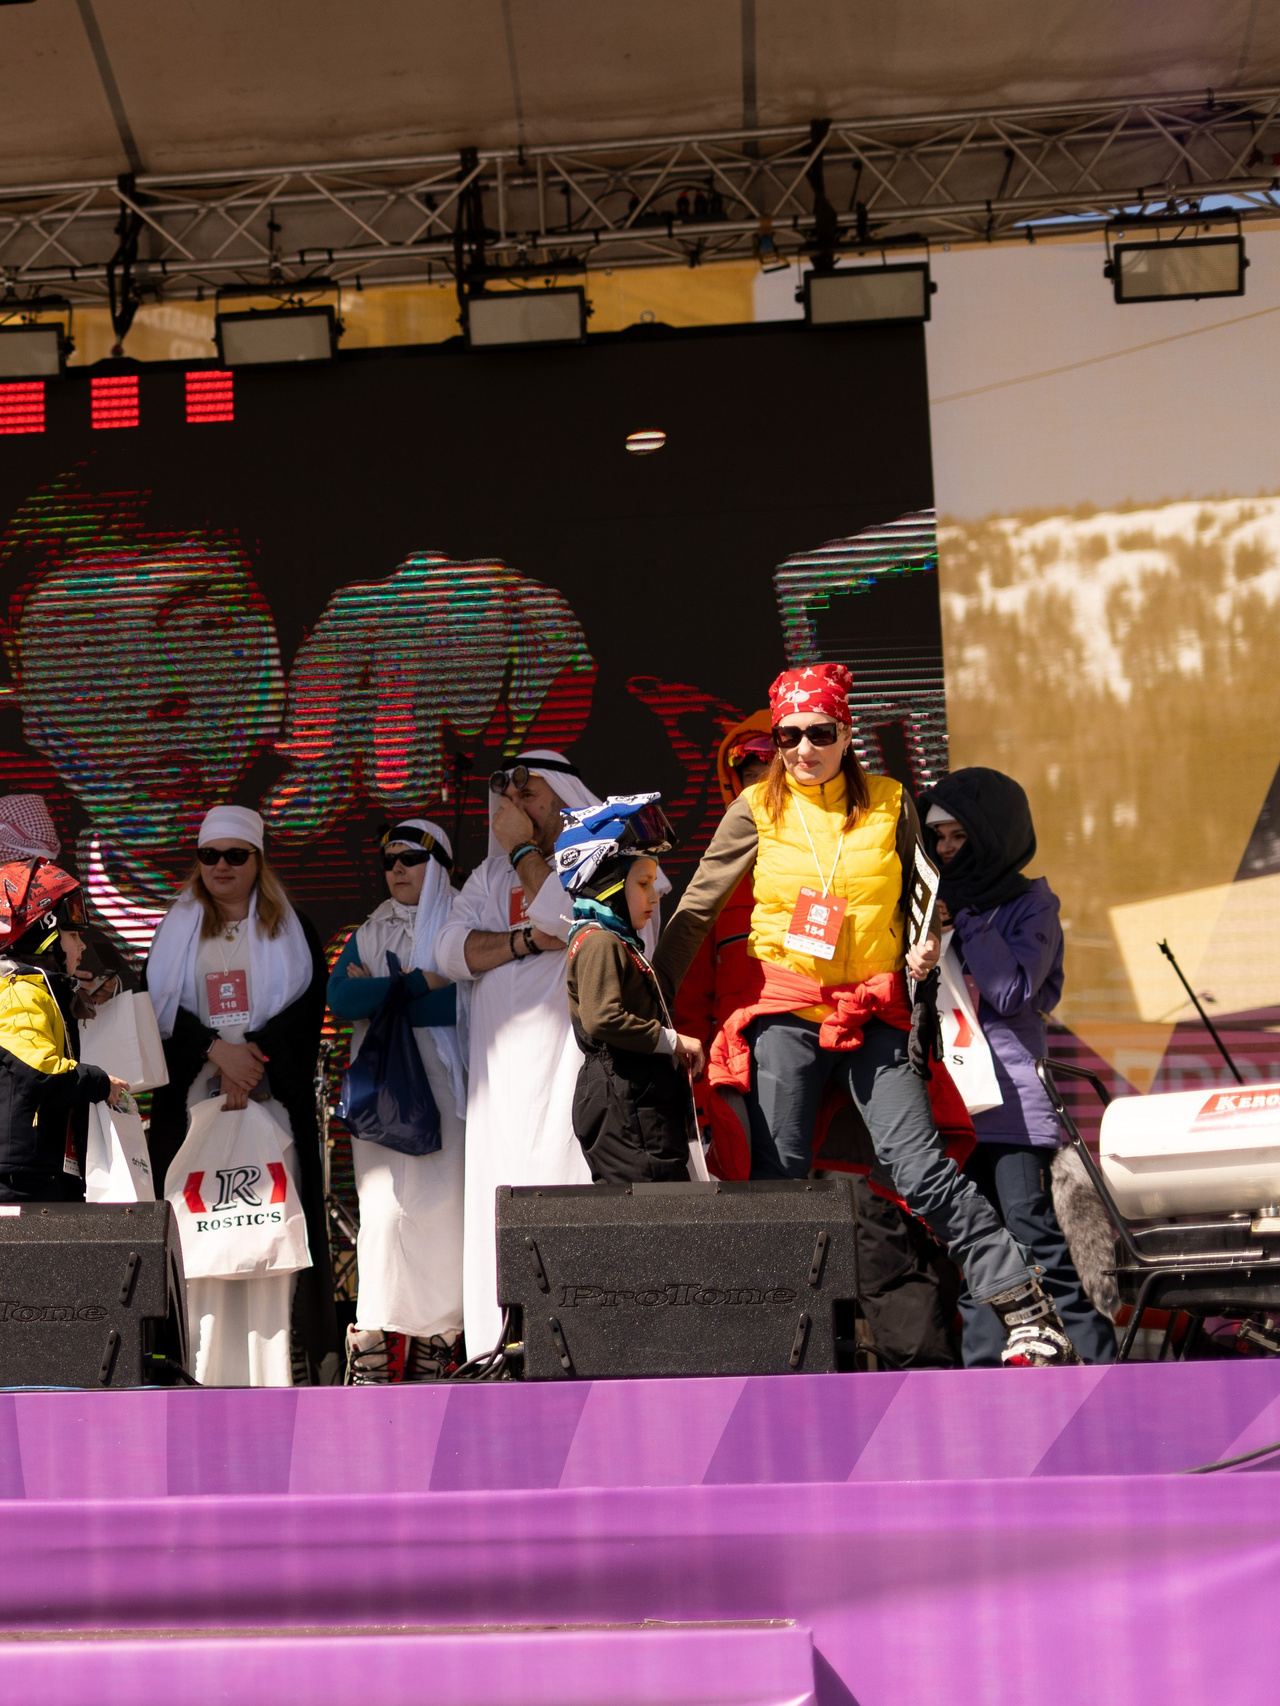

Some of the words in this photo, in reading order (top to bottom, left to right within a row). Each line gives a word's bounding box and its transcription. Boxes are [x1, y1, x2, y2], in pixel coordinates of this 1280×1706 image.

[804, 924, 825, 937] 154
[220, 1000, 237, 1009] 118
[211, 1165, 262, 1212] R
[196, 1211, 282, 1232] ROSTIC'S
[559, 1284, 797, 1307] ProTone
